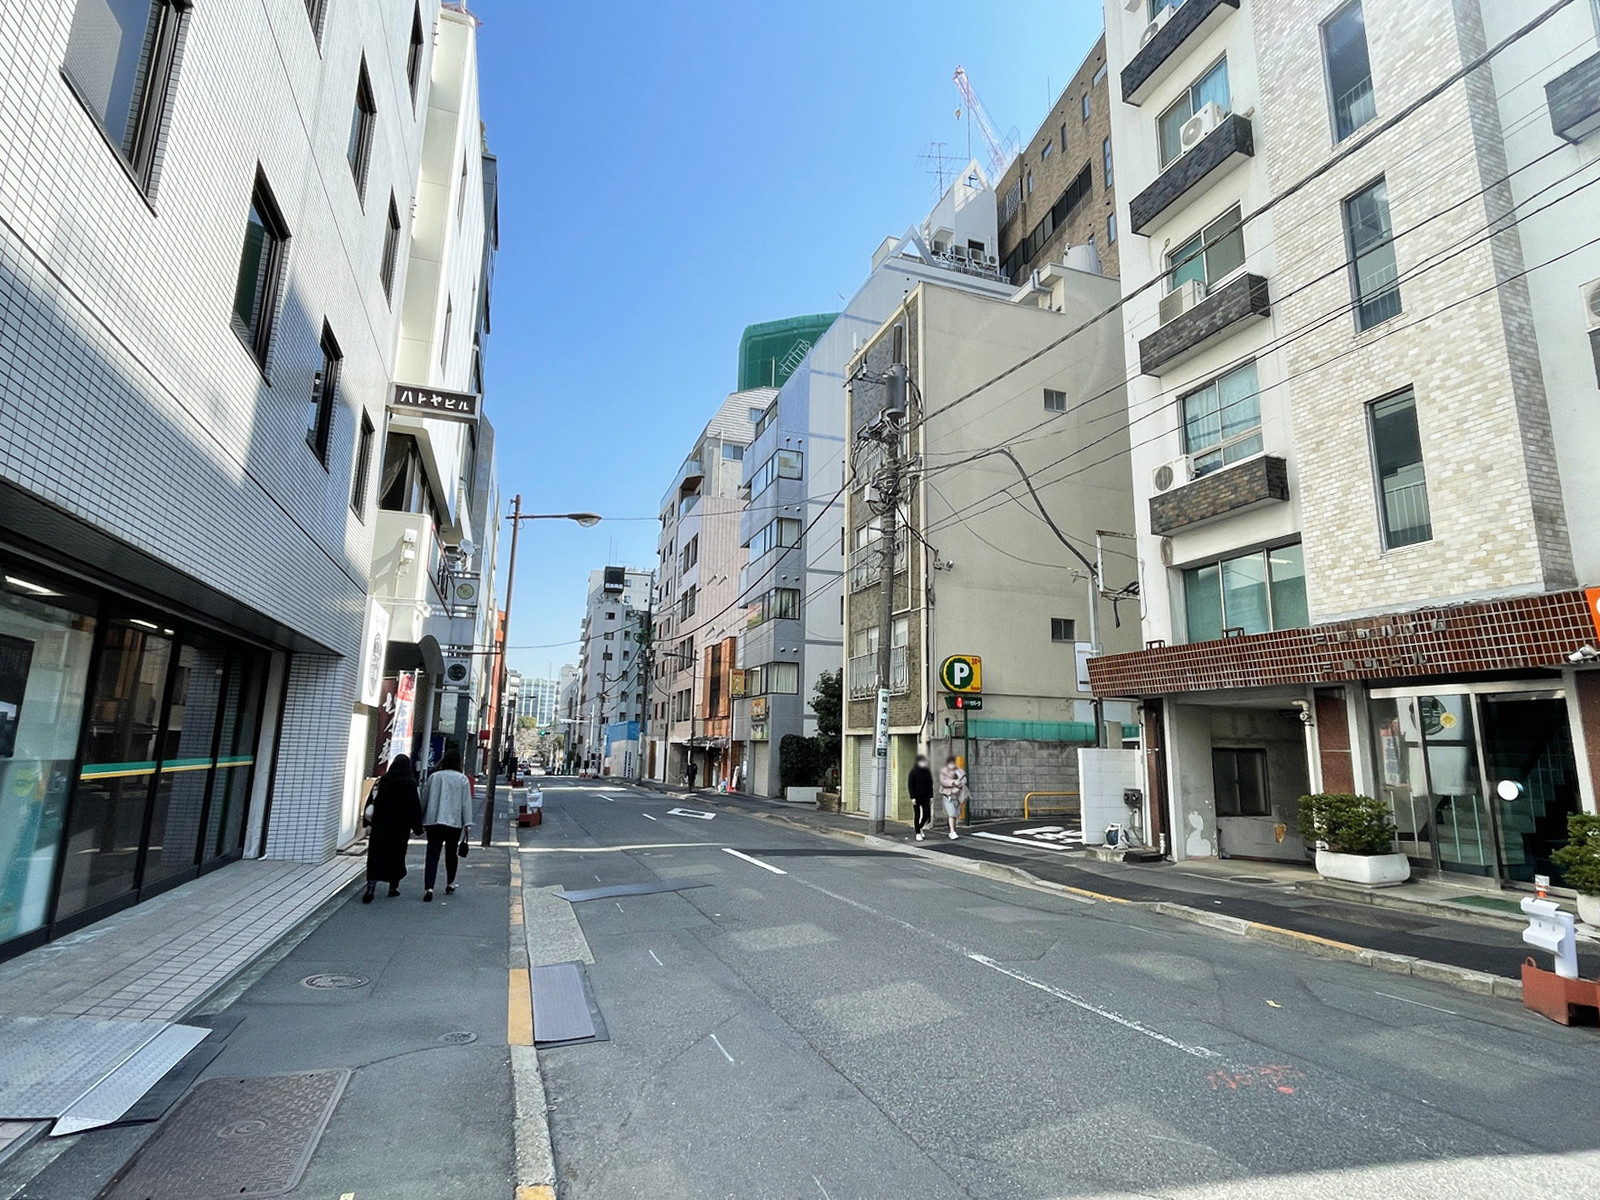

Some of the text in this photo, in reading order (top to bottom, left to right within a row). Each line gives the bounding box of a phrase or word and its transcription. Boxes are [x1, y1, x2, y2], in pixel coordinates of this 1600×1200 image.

[400, 390, 469, 411] ハトヤビル
[954, 662, 970, 685] P
